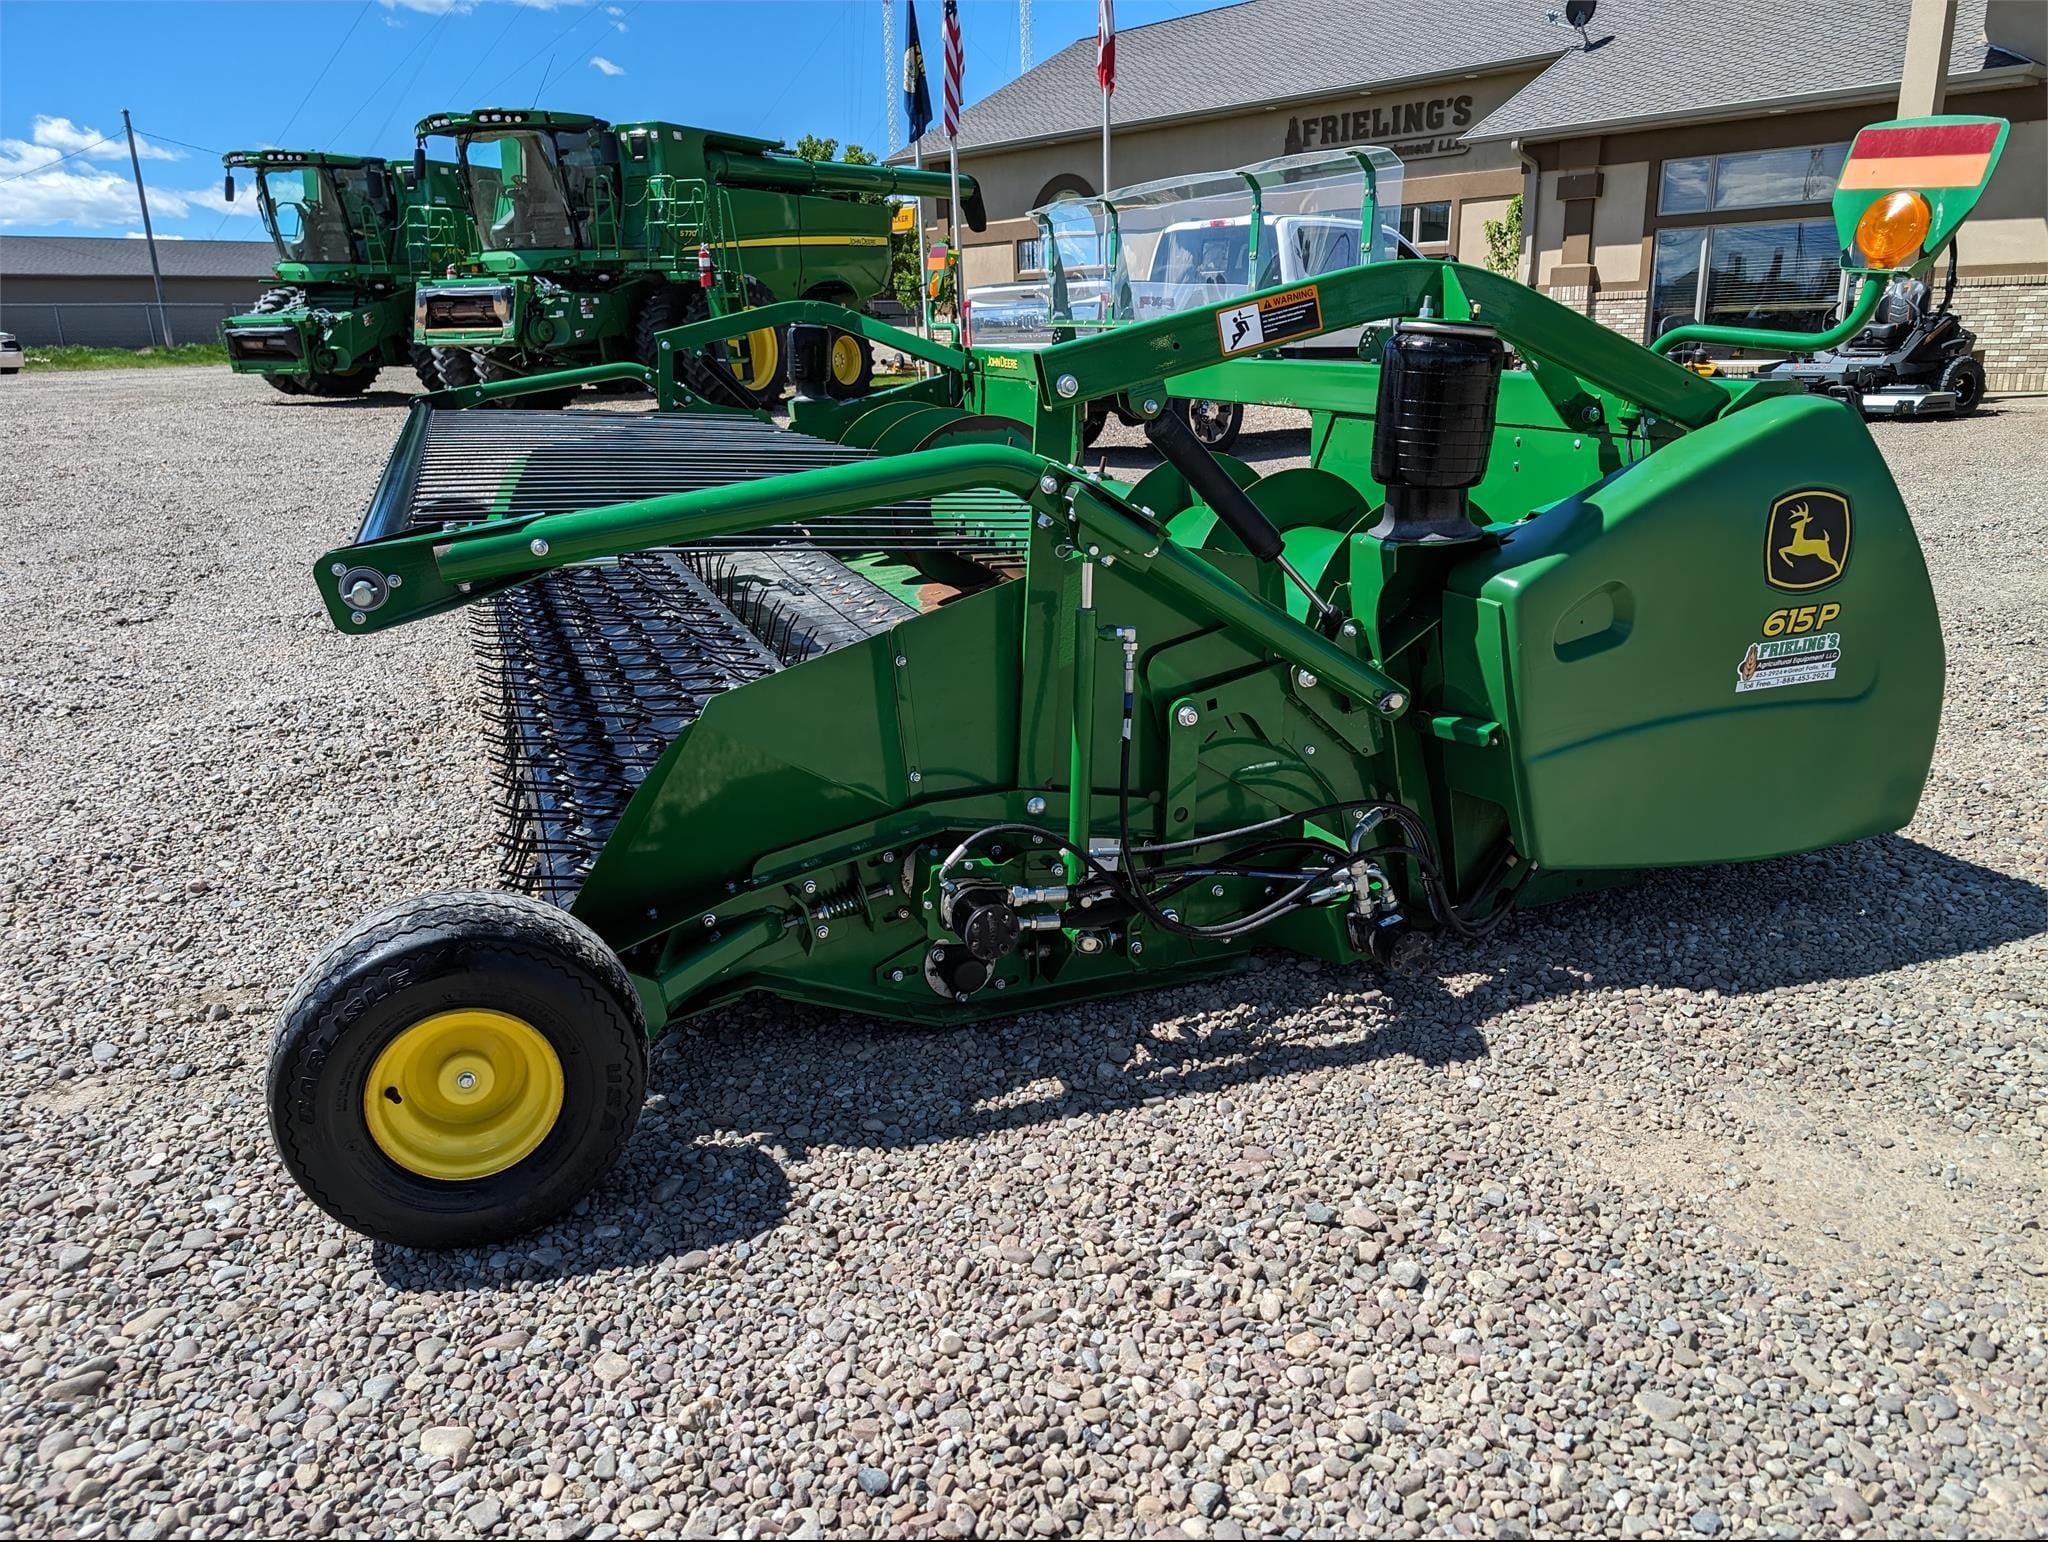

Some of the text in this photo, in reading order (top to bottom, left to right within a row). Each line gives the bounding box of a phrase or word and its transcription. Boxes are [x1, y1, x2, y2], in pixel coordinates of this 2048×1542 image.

[1302, 95, 1473, 147] FRIELING'S
[679, 229, 697, 237] S770
[1272, 288, 1314, 305] WARNING
[987, 354, 1018, 370] JOHN DEERE
[1762, 602, 1841, 637] 615P
[1758, 633, 1839, 658] FRIELING'S
[1757, 652, 1838, 670] Agricultural Equipment LLC
[1743, 682, 1754, 690] Toll
